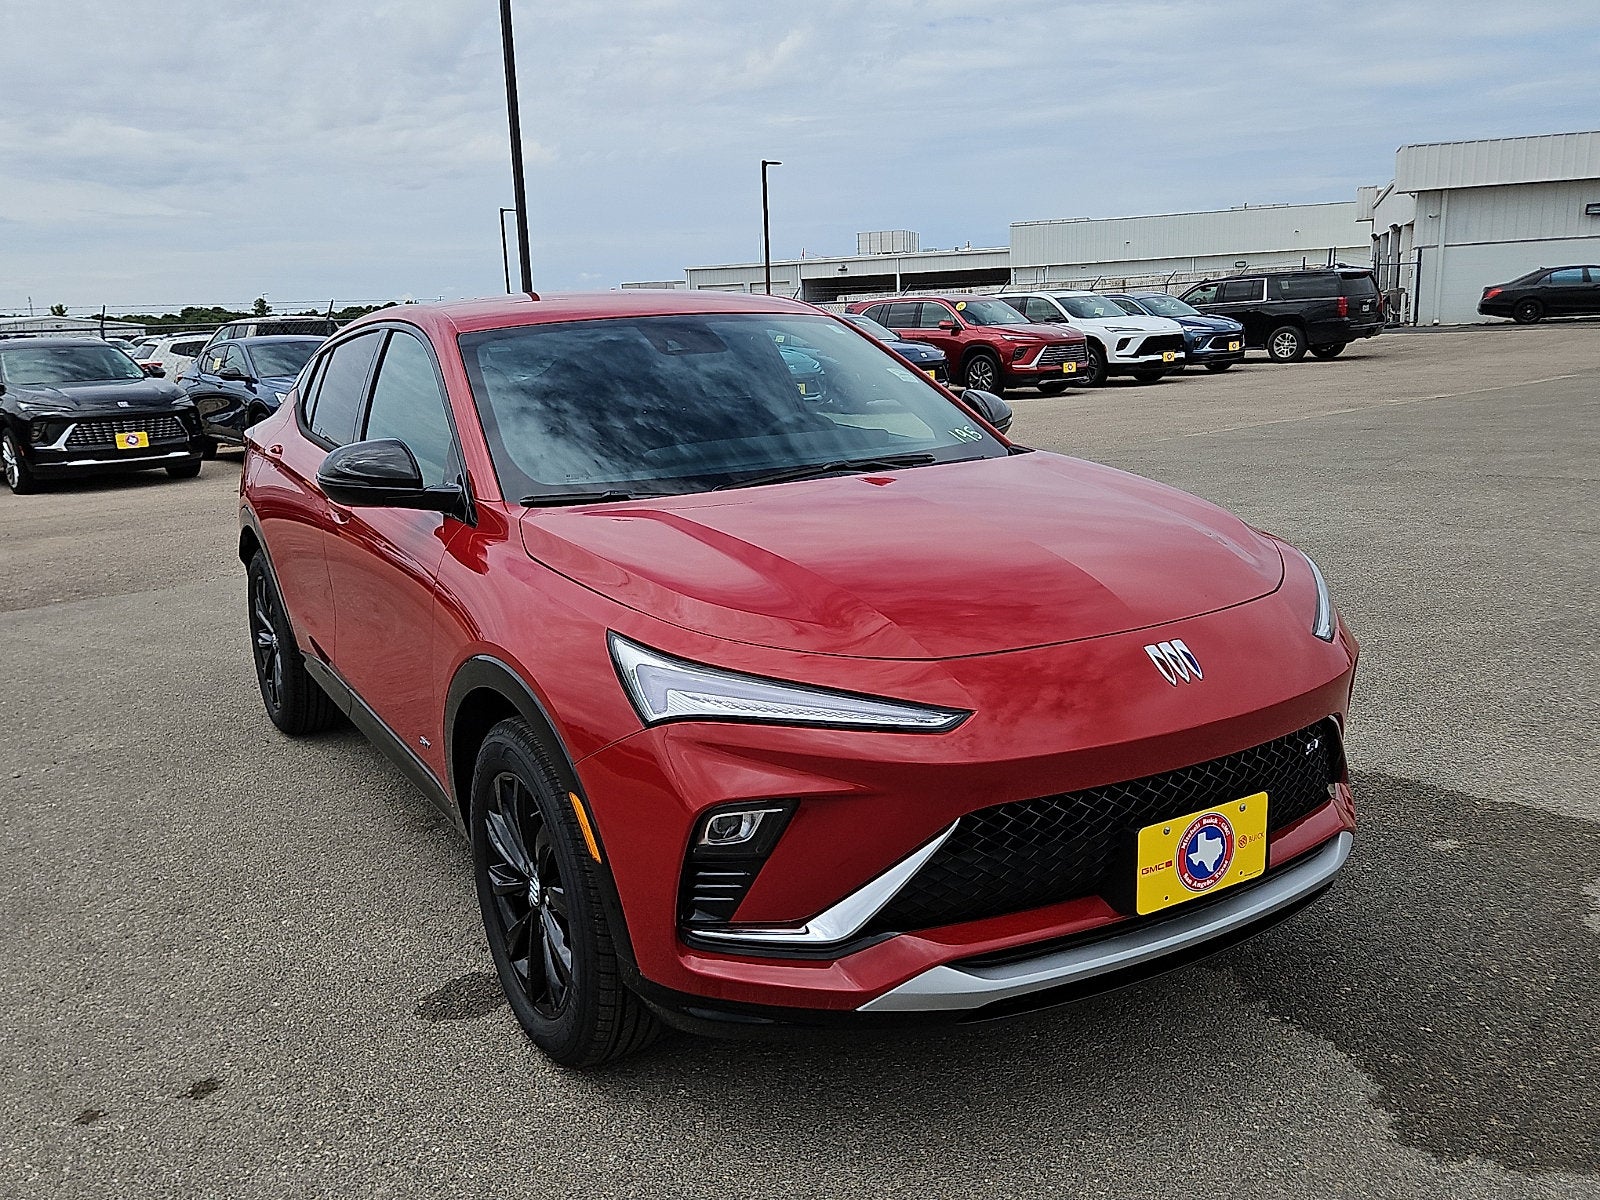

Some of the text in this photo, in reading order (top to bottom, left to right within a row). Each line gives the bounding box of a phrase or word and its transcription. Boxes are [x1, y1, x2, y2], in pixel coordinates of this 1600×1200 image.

[1181, 823, 1201, 850] Mitchell
[1202, 817, 1218, 825] Buick
[1141, 862, 1166, 876] GMC
[1183, 872, 1193, 885] San
